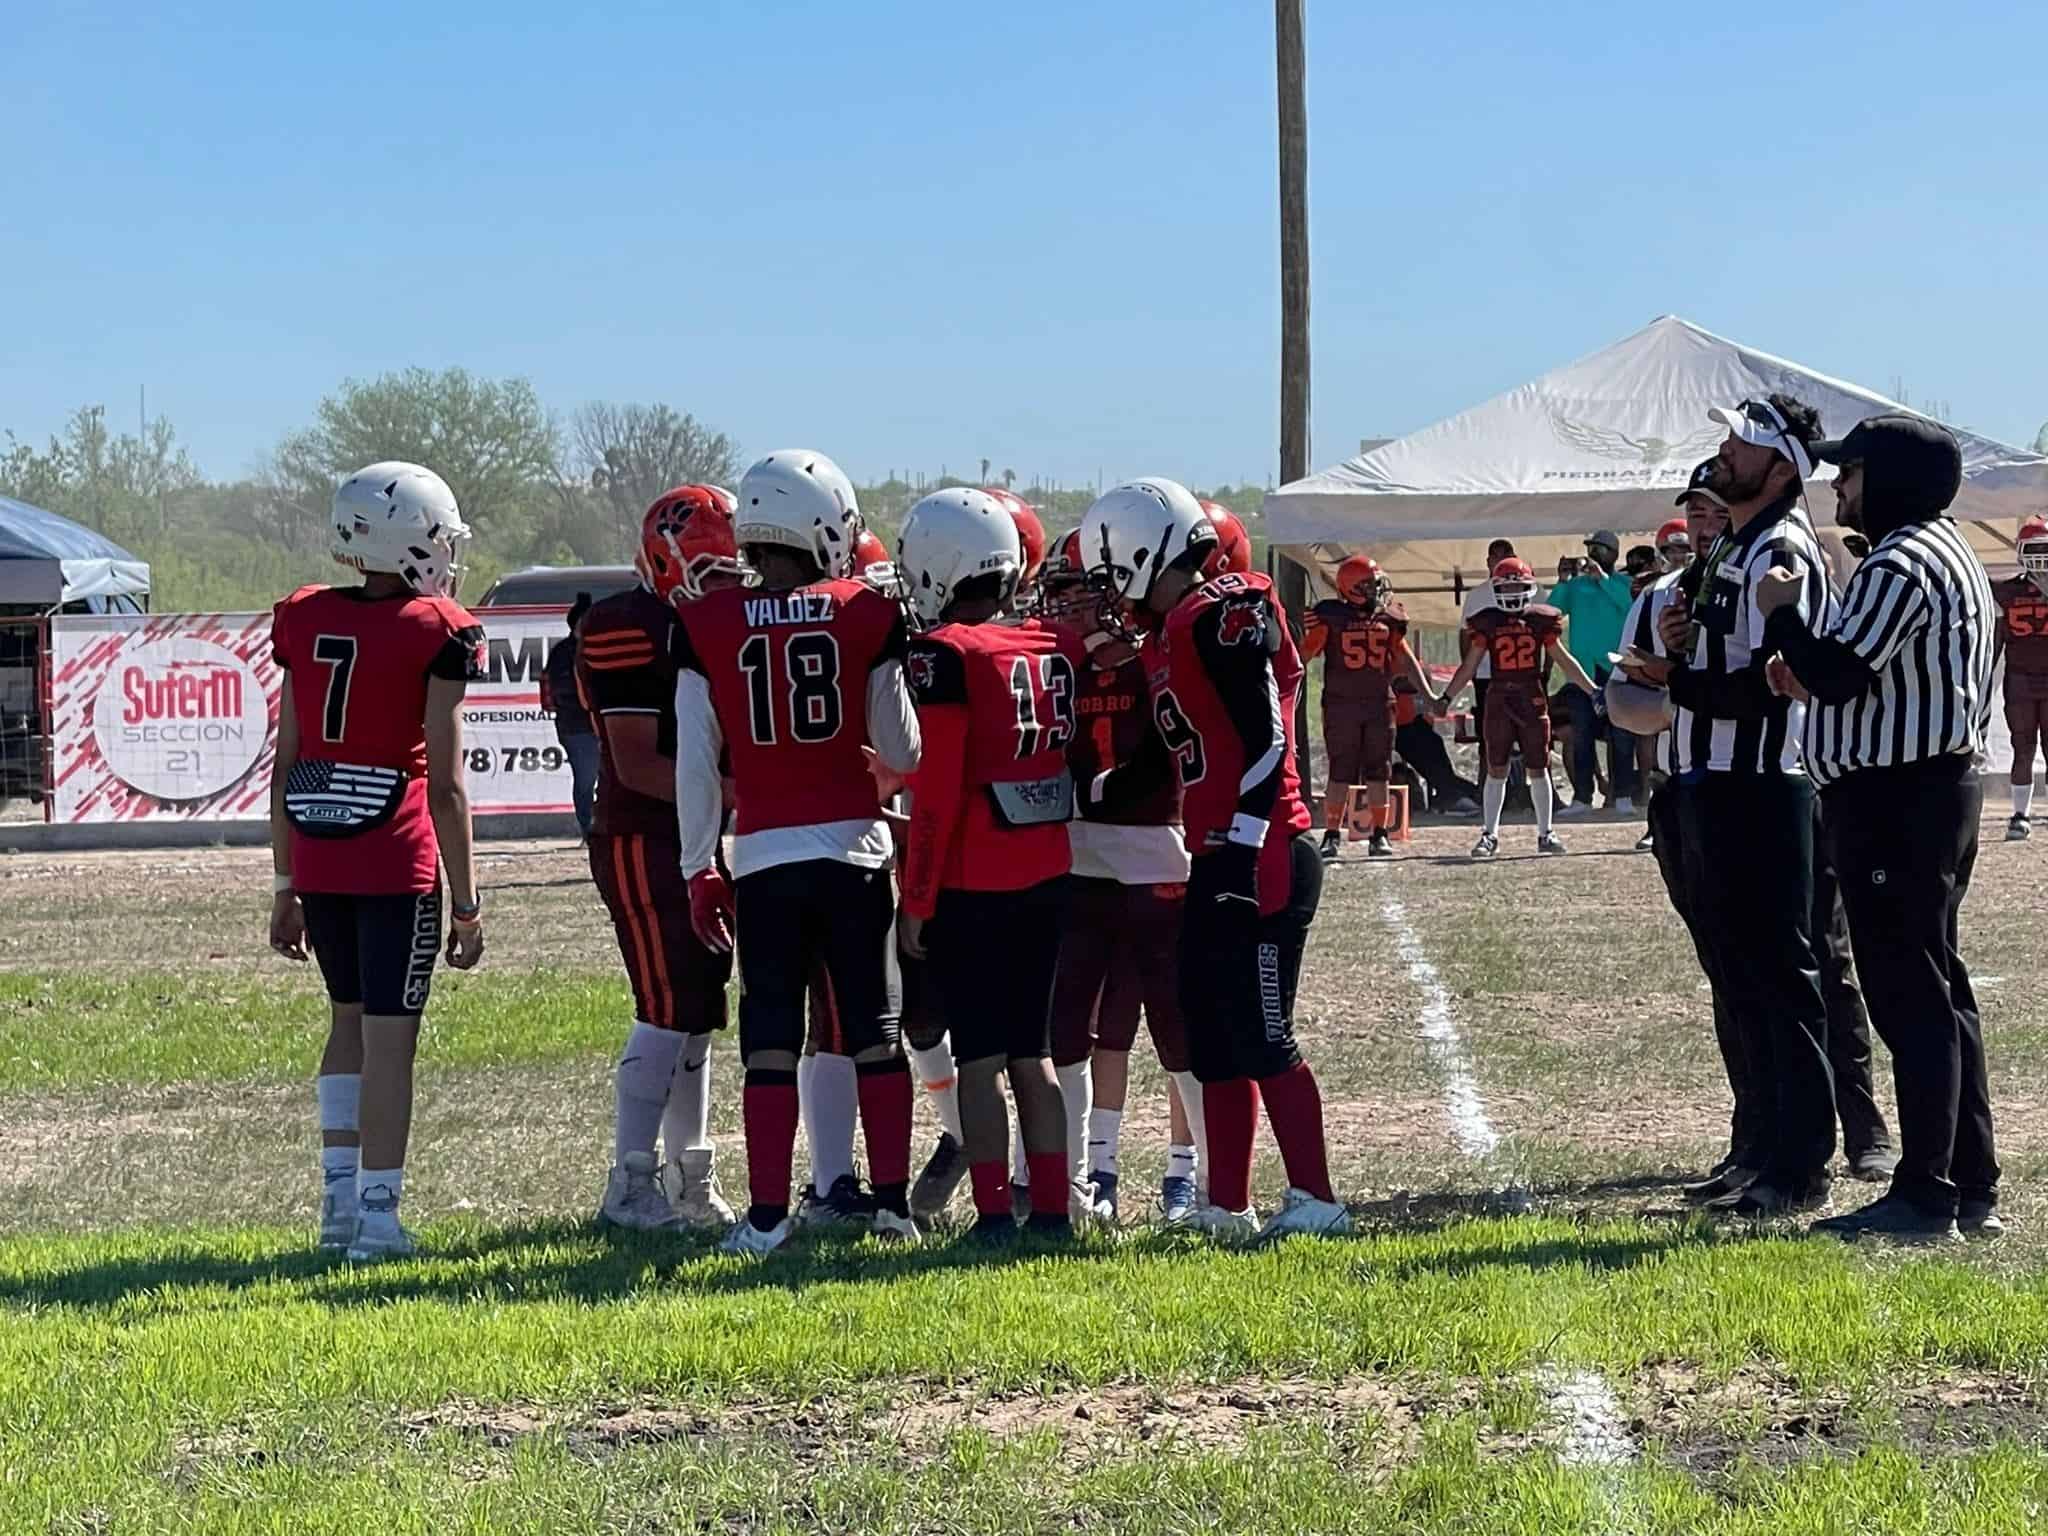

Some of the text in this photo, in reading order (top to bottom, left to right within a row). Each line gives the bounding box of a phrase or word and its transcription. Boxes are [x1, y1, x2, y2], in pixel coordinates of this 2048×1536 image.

[1199, 572, 1249, 601] 19
[743, 592, 835, 628] VALDEZ
[1341, 630, 1389, 671] 55
[1495, 634, 1537, 670] 22
[123, 665, 243, 725] Suterm
[313, 634, 358, 744] 7
[737, 630, 843, 745] 18
[1010, 653, 1076, 760] 13
[123, 723, 244, 743] SECCION
[462, 711, 557, 723] ROFESIONAL
[166, 750, 200, 771] 21
[403, 893, 440, 1010] AGONES
